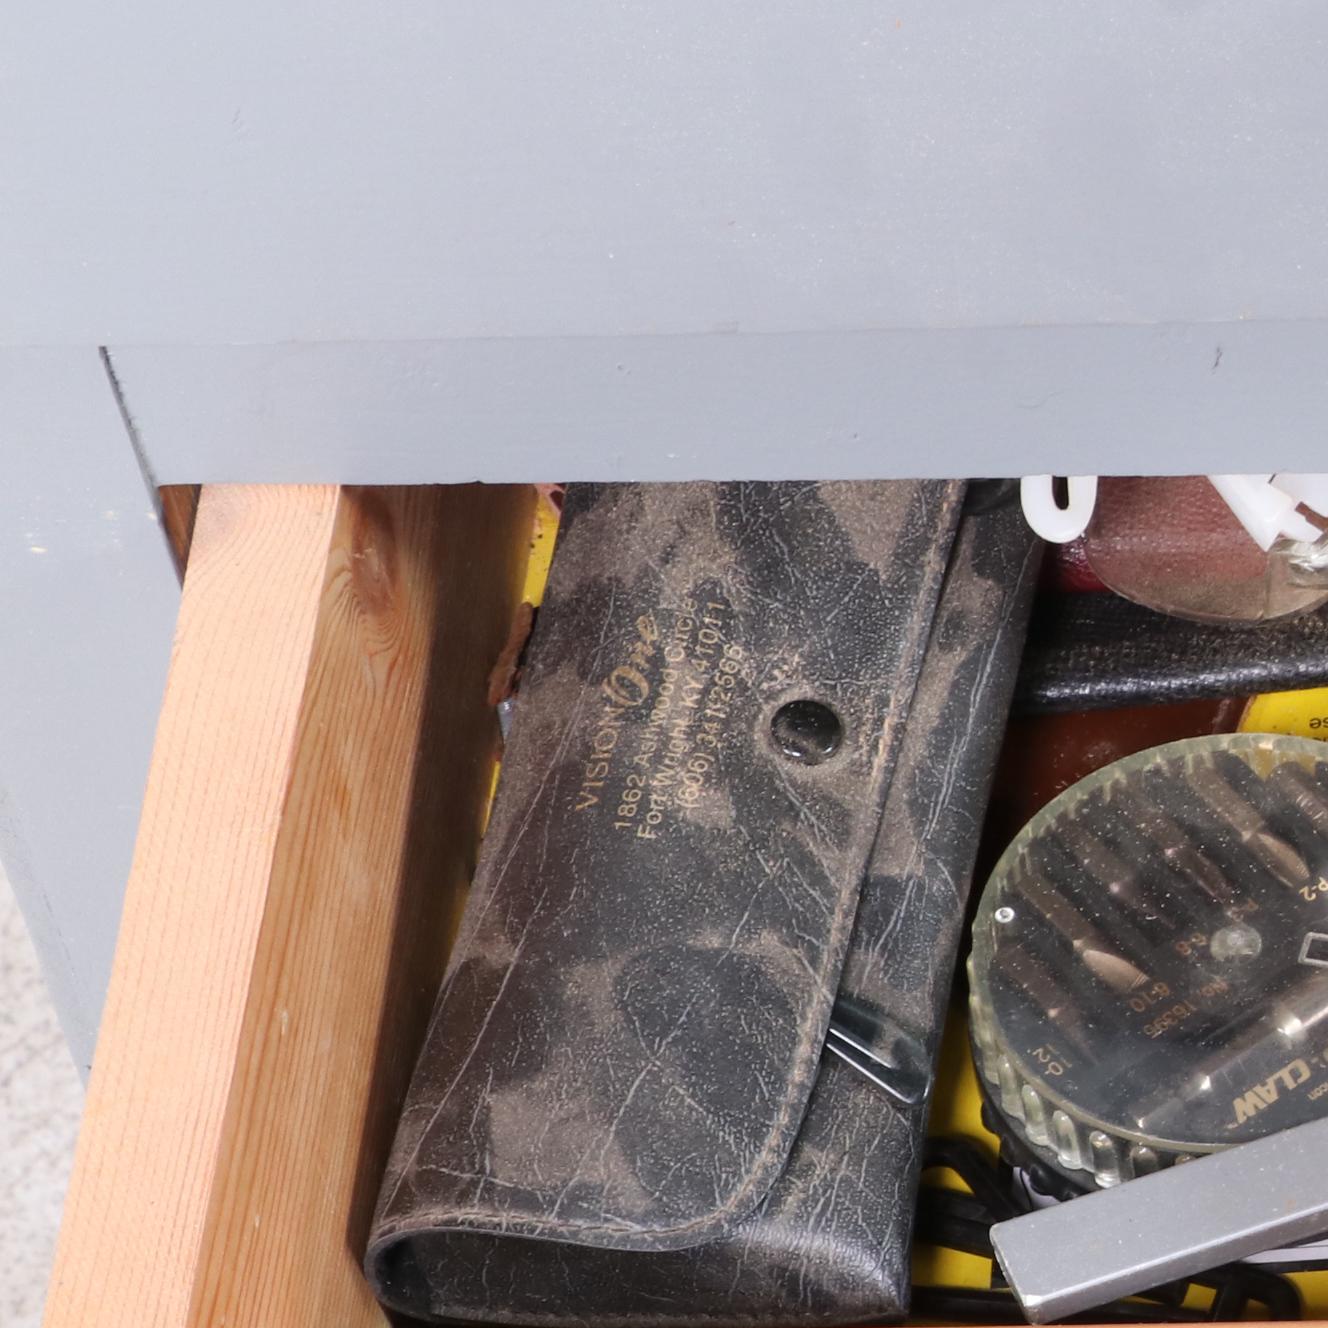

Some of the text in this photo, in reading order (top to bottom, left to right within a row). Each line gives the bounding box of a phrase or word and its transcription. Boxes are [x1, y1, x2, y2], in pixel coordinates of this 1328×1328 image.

[691, 601, 726, 672] 41011
[613, 597, 698, 831] 1862 Ashwood Circle
[681, 673, 704, 709] KY
[576, 702, 627, 812] VISION
[675, 751, 716, 809] (606)
[636, 793, 667, 839] Fort
